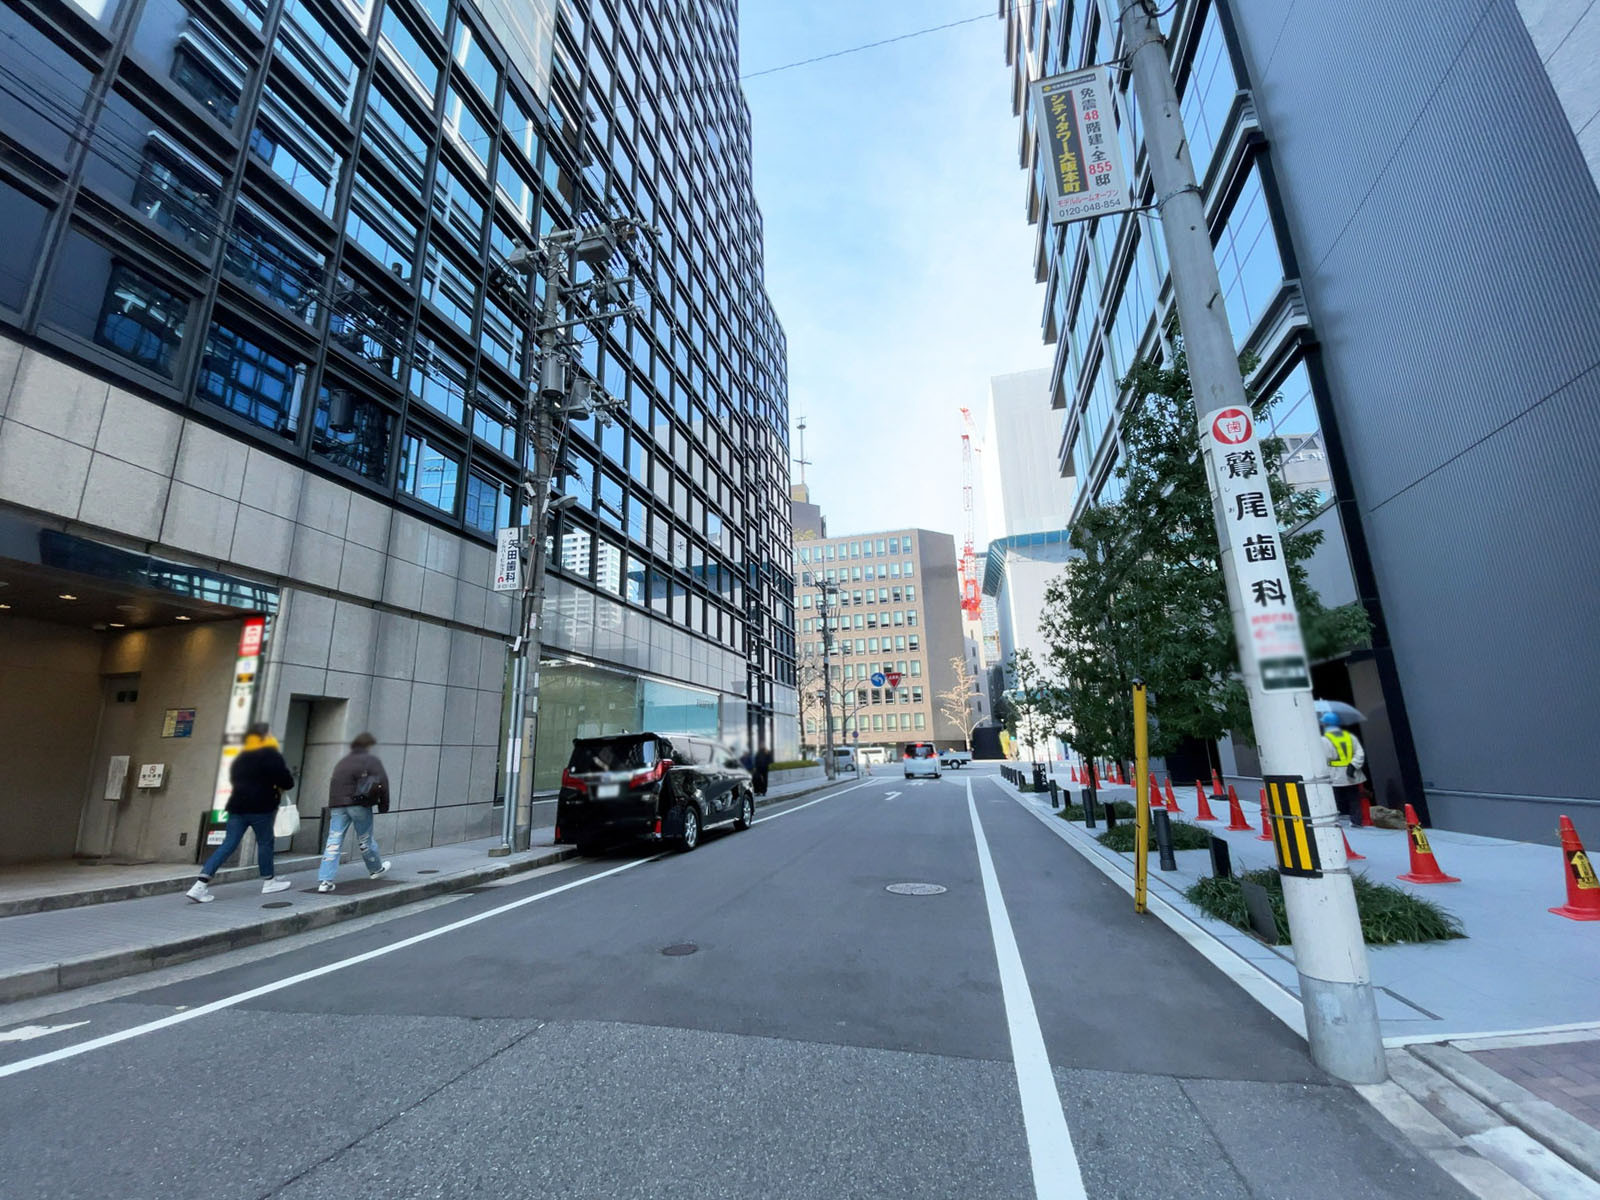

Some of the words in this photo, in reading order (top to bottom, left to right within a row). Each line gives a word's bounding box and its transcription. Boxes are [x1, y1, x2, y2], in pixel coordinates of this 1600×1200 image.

[1050, 94, 1081, 194] シティタワー大阪本町
[1059, 198, 1121, 218] 0120-048-854
[1224, 449, 1287, 607] 鷲尾歯科
